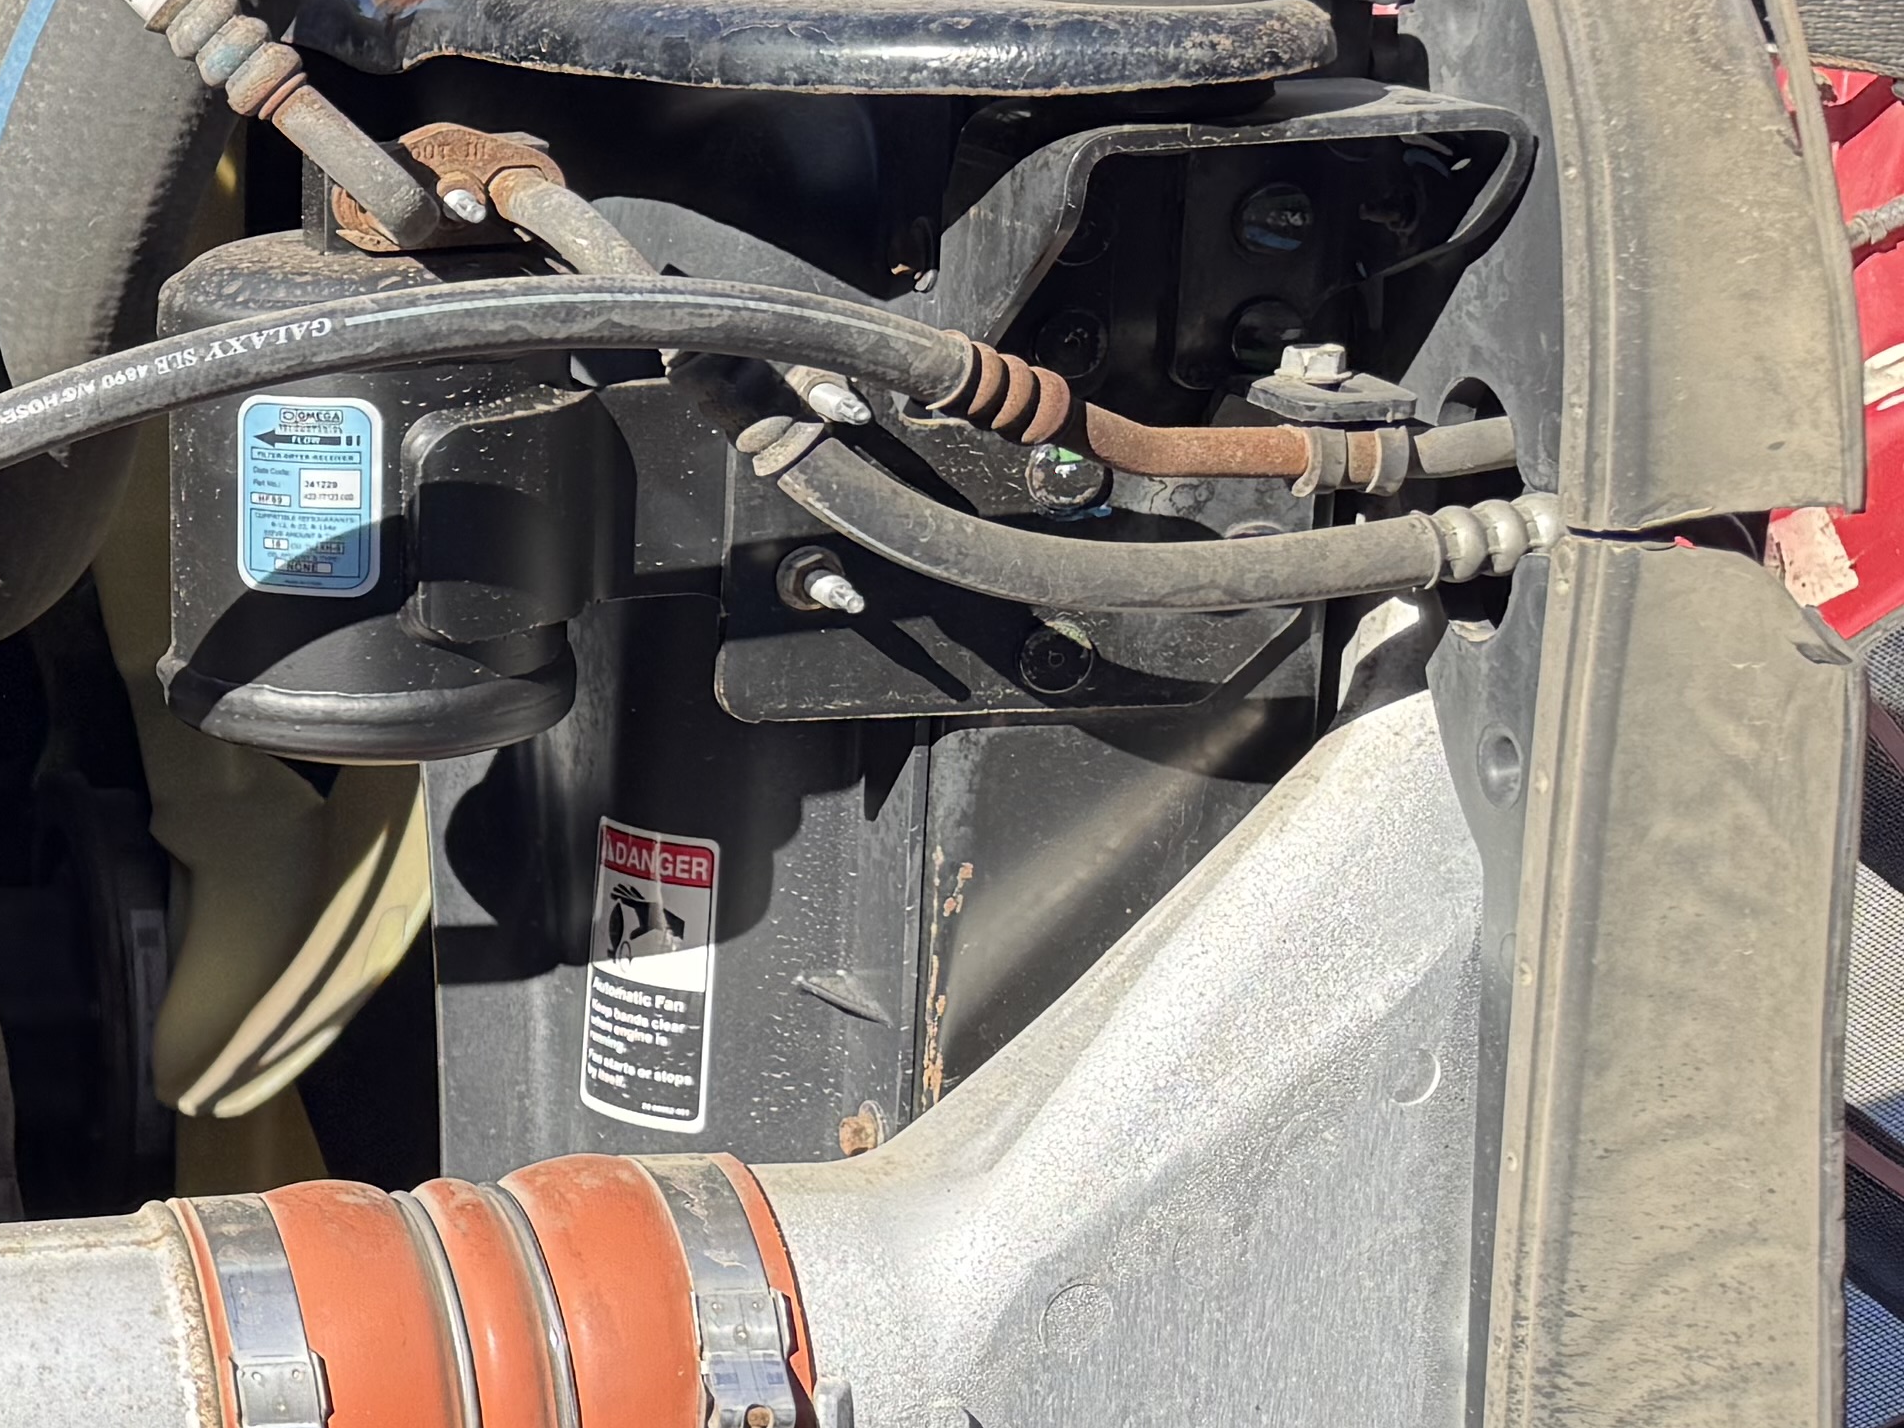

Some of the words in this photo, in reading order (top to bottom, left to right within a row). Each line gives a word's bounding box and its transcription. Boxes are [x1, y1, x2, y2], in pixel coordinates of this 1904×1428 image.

[201, 314, 334, 366] GALAXY
[152, 346, 199, 376] SLE
[60, 377, 97, 405] A/C
[101, 362, 150, 392] 4890
[2, 387, 61, 424] HOSE
[297, 411, 341, 422] OMEGA
[291, 436, 321, 445] FLOW
[615, 840, 709, 882] DANGER
[592, 975, 652, 1009] Automatic
[655, 993, 686, 1013] Fan
[590, 998, 613, 1019] Keep
[614, 1006, 649, 1028] hands
[651, 1017, 686, 1035] clear
[613, 1023, 654, 1046] engine
[655, 1032, 668, 1048] is
[603, 1054, 636, 1076] starts
[637, 1067, 651, 1081] or
[652, 1066, 692, 1087] stops
